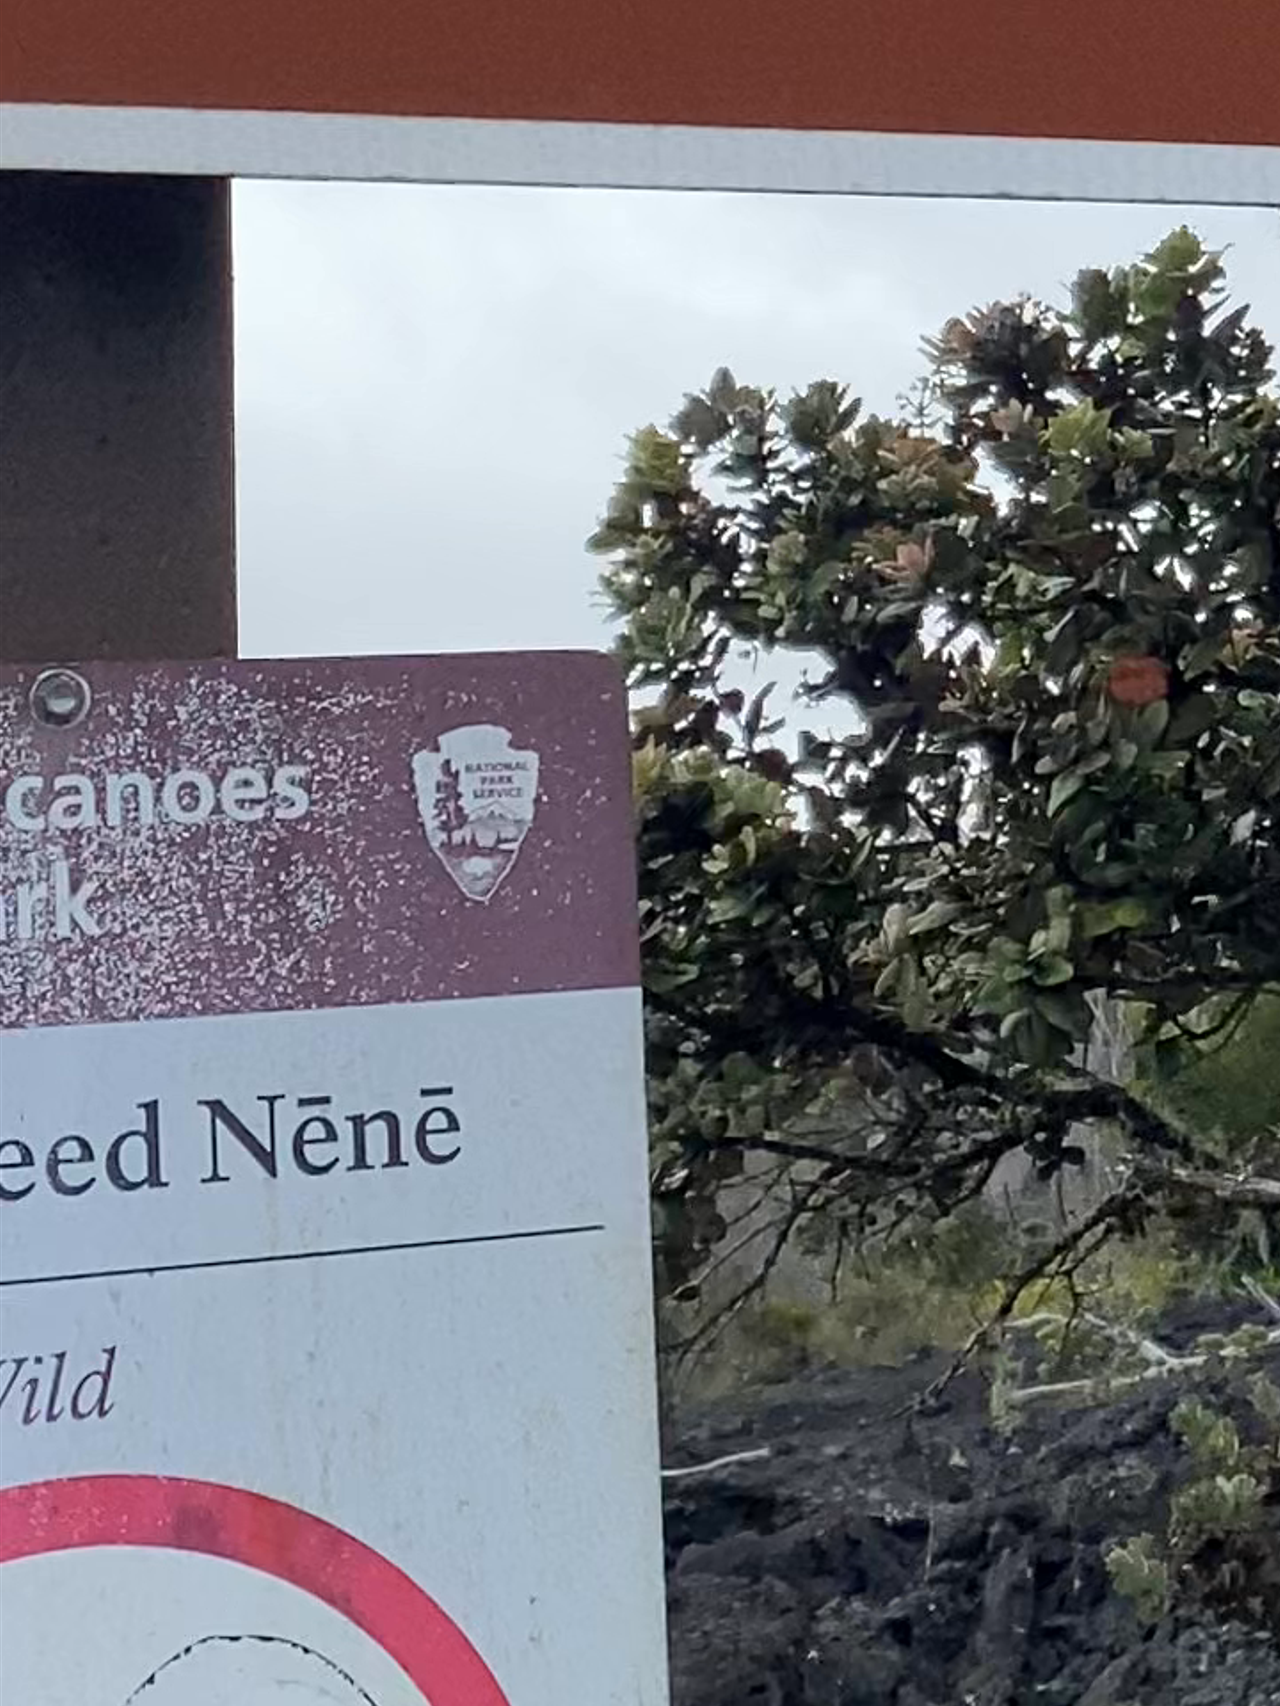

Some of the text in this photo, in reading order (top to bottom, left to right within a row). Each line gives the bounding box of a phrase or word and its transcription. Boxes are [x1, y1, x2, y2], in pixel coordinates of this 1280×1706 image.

[464, 762, 529, 774] NATIONAL
[479, 775, 514, 785] PARK
[5, 766, 311, 830] canoes
[472, 787, 523, 799] SERVICE
[196, 1086, 462, 1184] Nēnē
